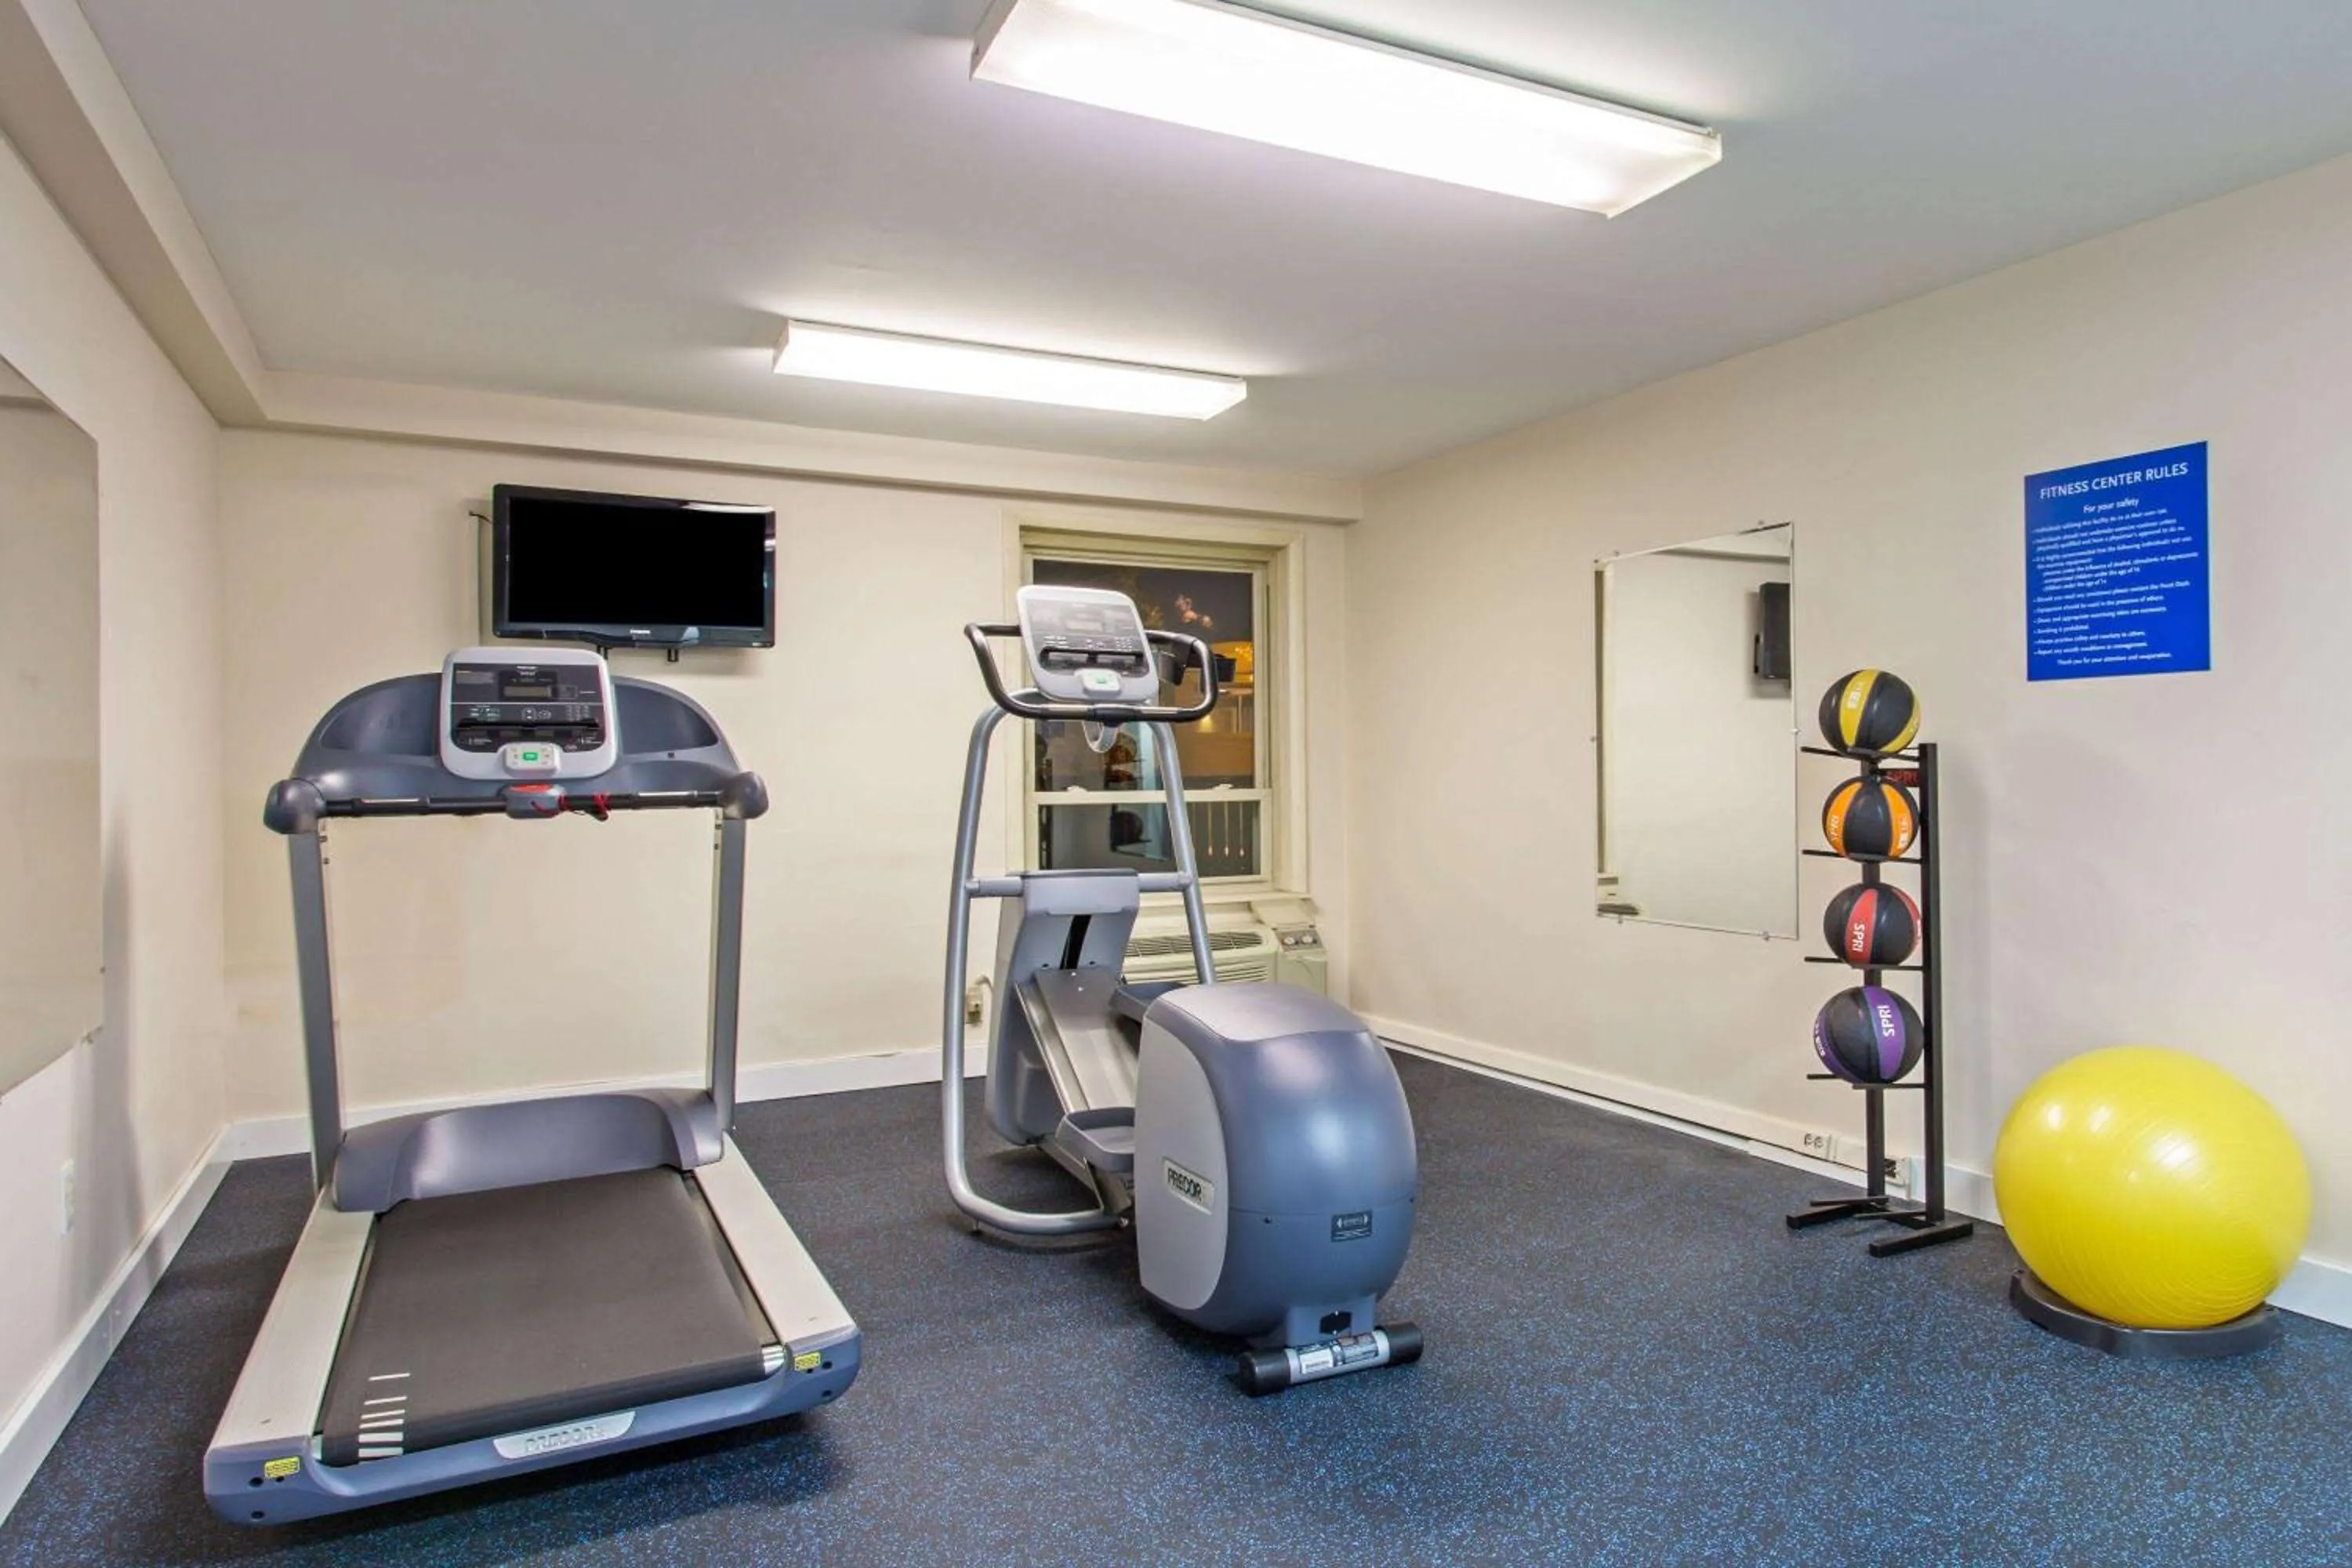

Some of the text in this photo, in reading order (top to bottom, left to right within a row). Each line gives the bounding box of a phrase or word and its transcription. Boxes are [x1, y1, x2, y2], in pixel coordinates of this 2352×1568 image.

[2040, 462, 2189, 499] FITNESS CENTER RULES
[2083, 498, 2139, 514] For your safety
[1852, 923, 1865, 953] SPRI
[1877, 1004, 1895, 1037] SPRI
